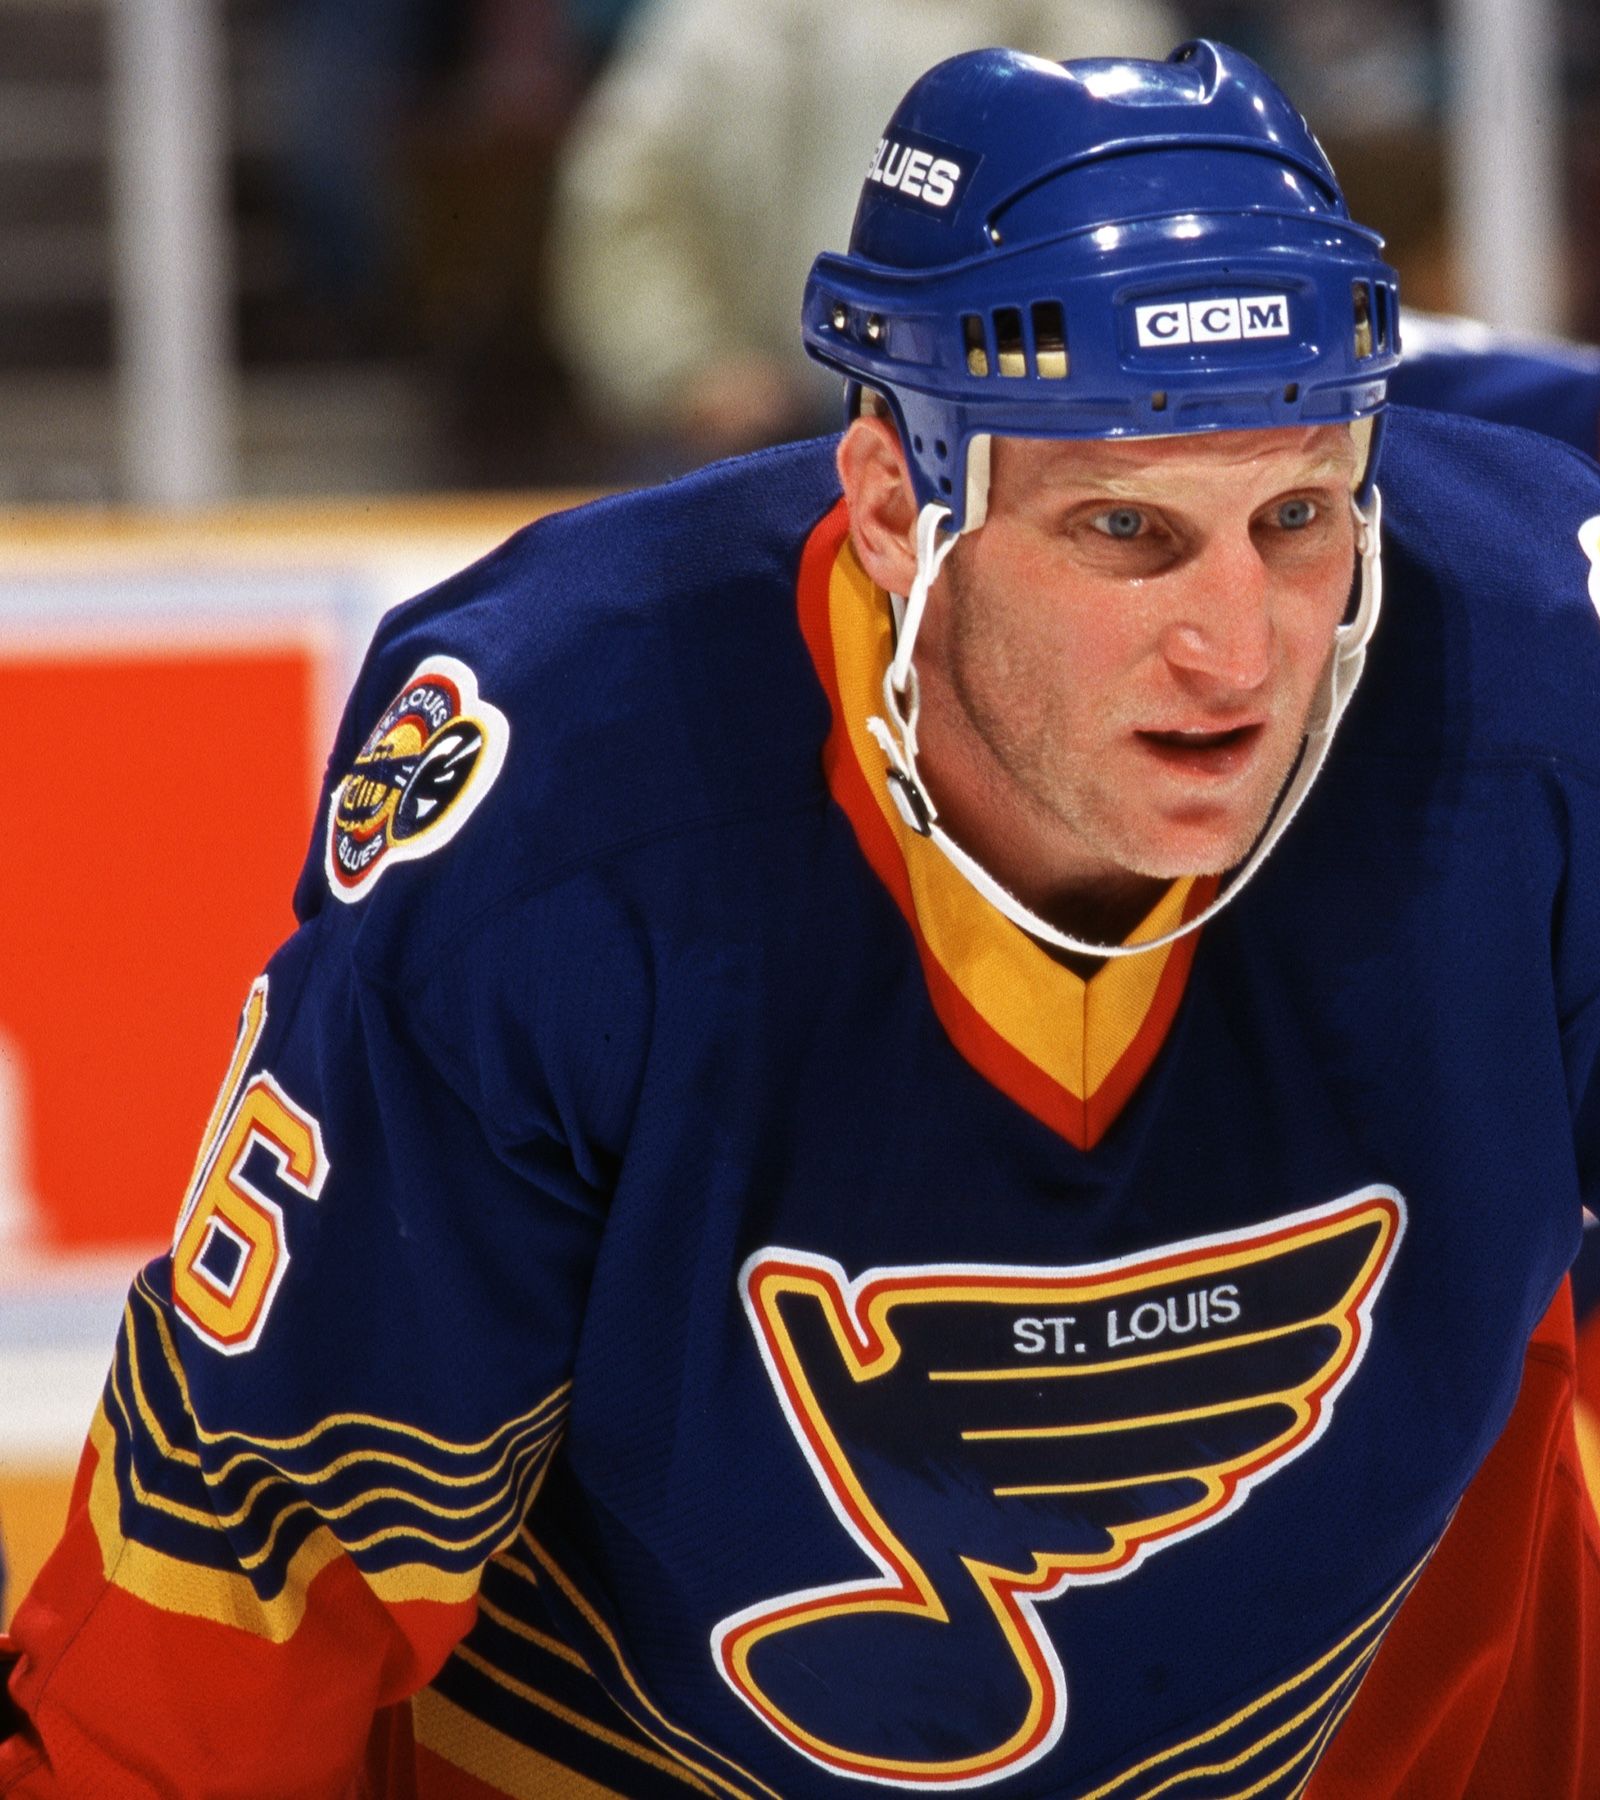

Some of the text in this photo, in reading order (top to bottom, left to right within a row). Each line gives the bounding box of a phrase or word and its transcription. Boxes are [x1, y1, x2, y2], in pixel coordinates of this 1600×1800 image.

[1146, 303, 1284, 339] CCM
[399, 688, 447, 728] LOUIS
[339, 834, 383, 871] BLUES
[1013, 1284, 1241, 1354] ST. LOUIS
